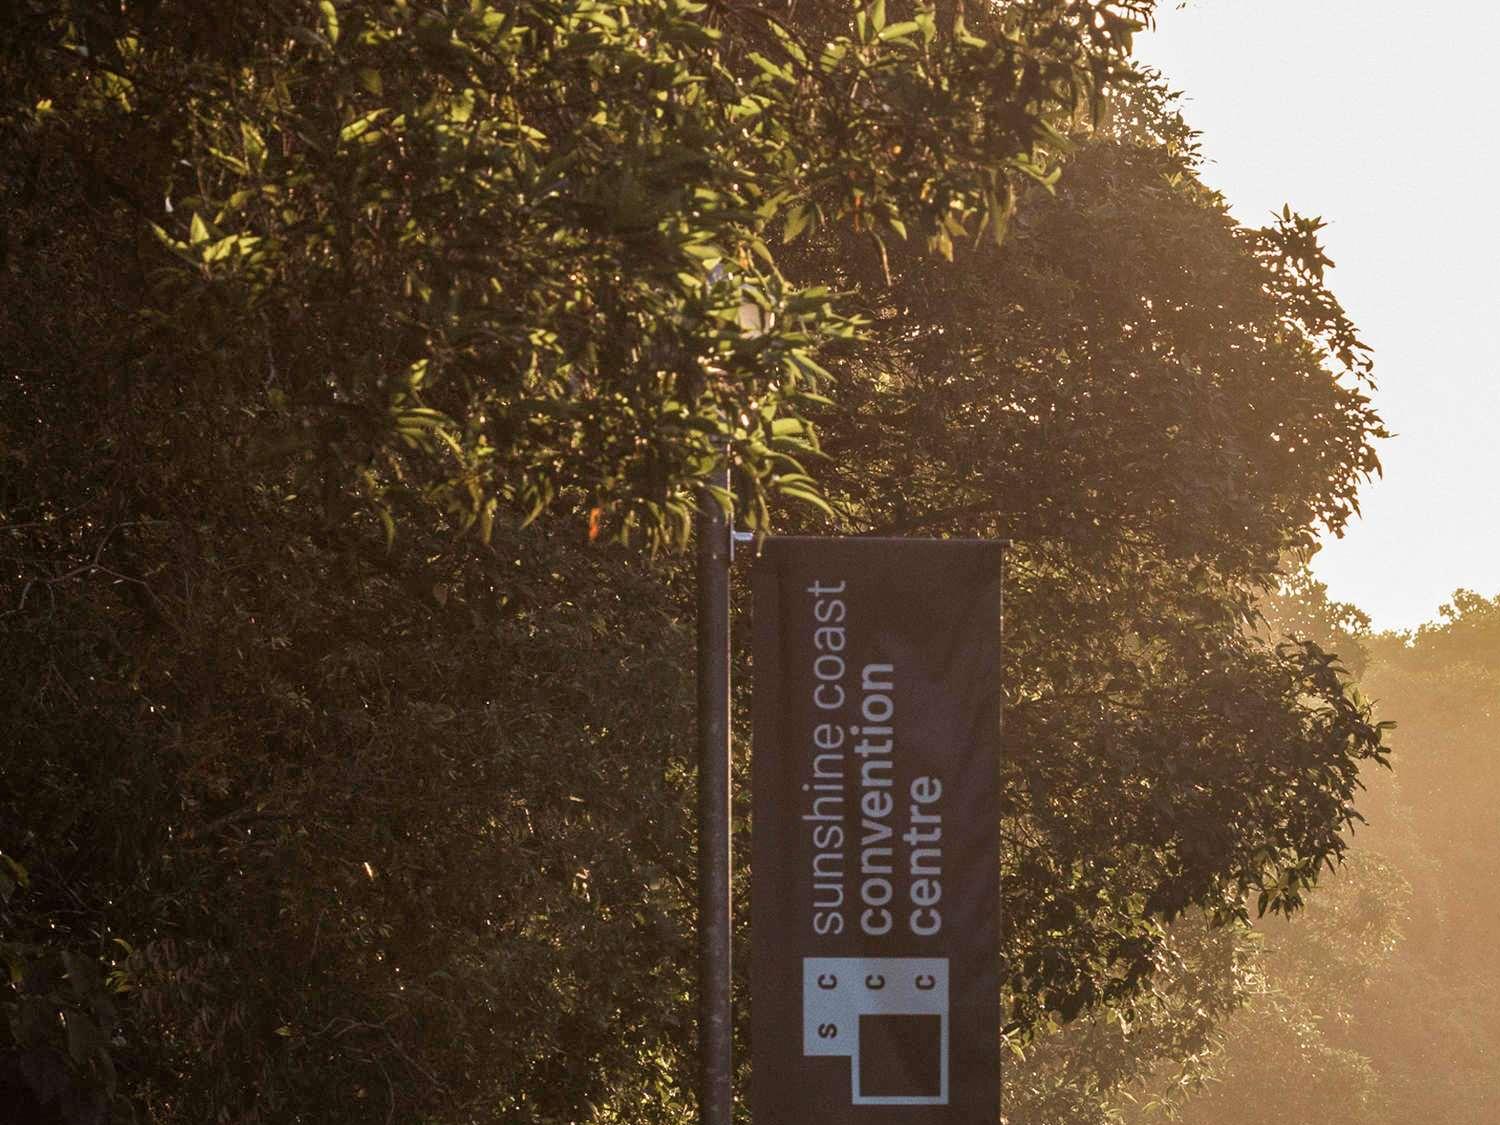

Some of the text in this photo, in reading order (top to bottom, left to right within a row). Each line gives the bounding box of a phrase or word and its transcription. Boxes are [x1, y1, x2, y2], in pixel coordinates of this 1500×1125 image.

[802, 578, 846, 936] sunshine coast
[851, 662, 894, 936] convention
[901, 775, 943, 936] centre
